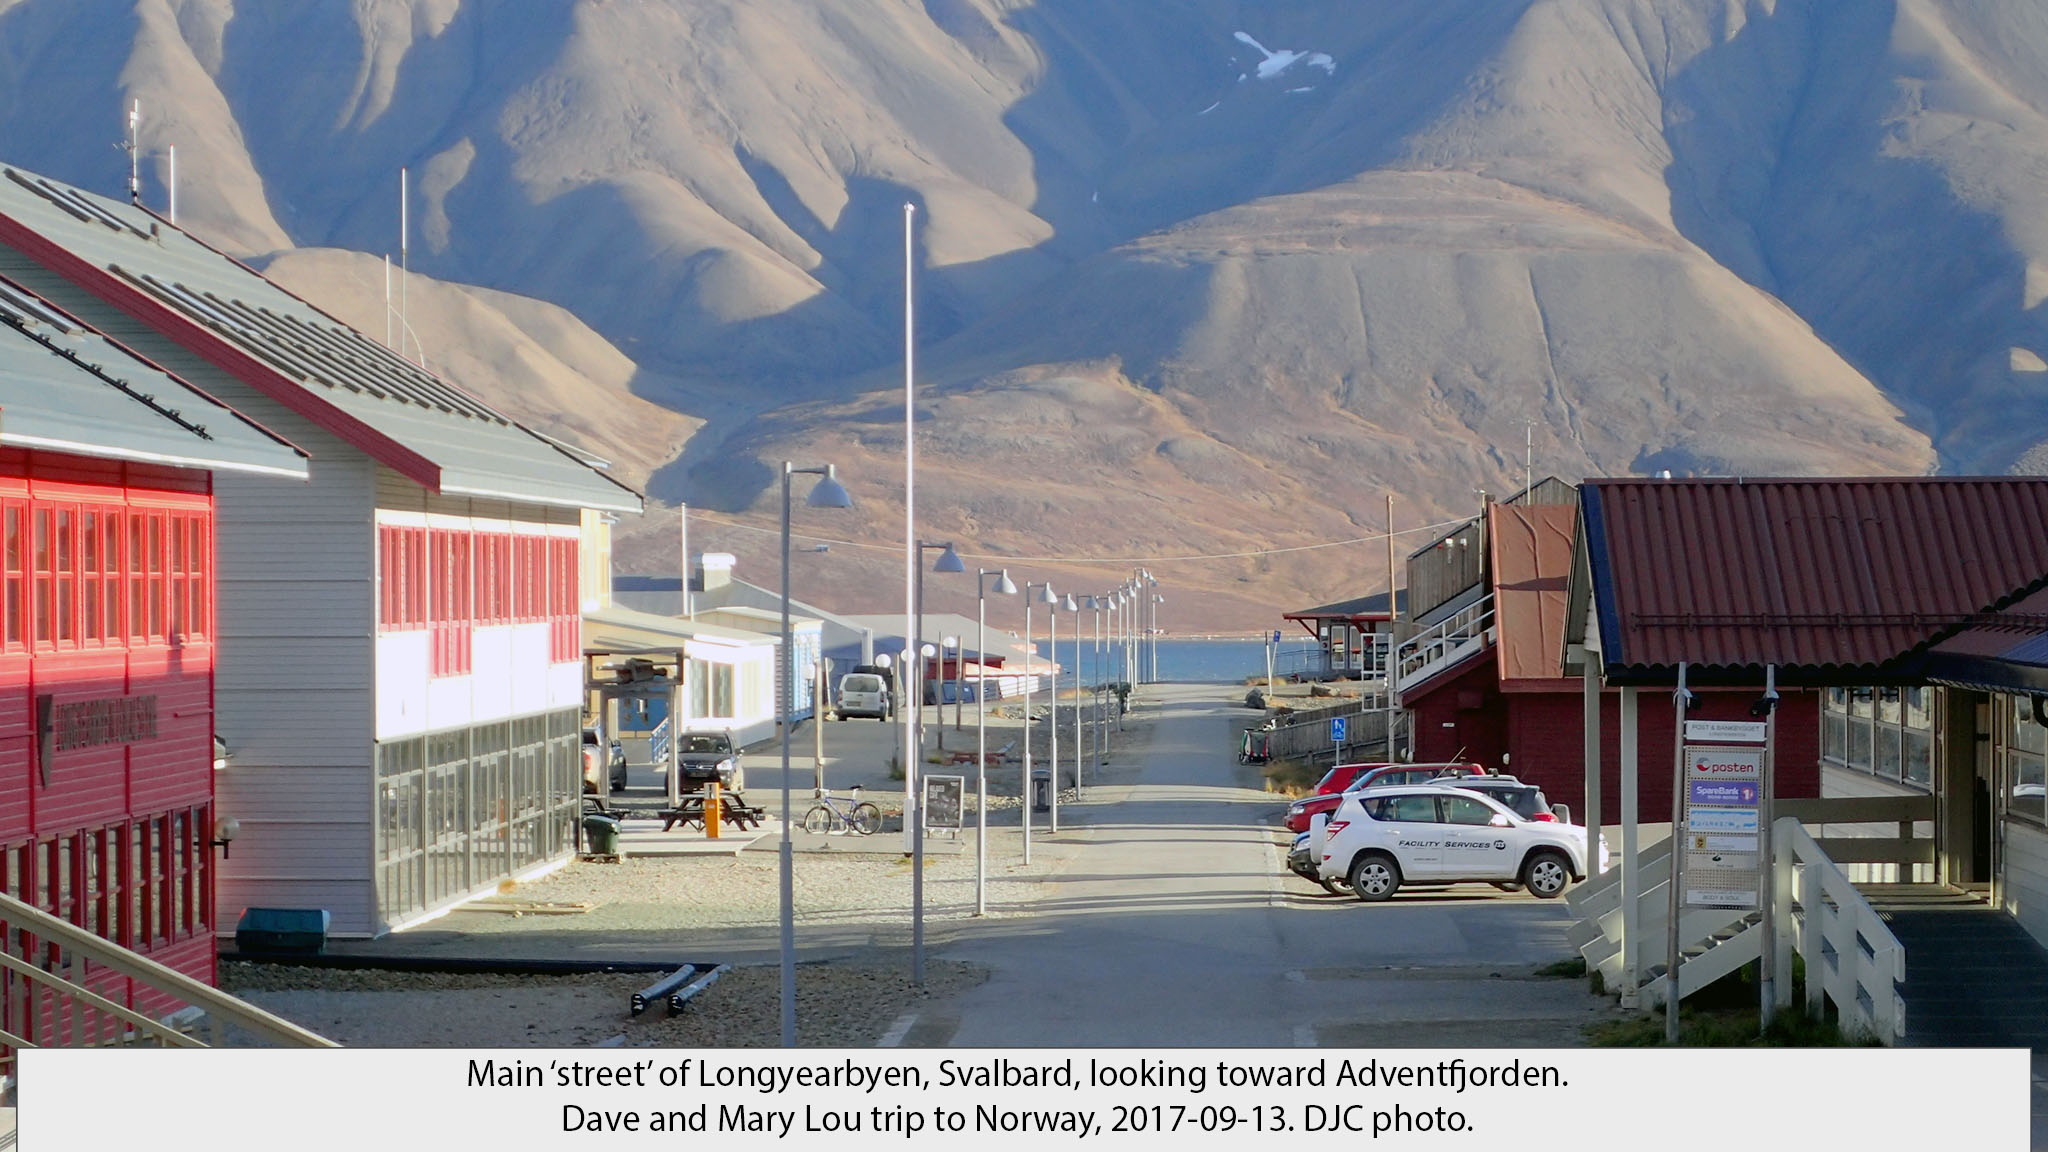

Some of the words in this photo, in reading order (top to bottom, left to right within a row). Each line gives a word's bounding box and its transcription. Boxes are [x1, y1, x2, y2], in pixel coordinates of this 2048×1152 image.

[1712, 763, 1754, 774] posten
[1696, 786, 1739, 796] SpareBank
[1444, 841, 1491, 849] SERVICES
